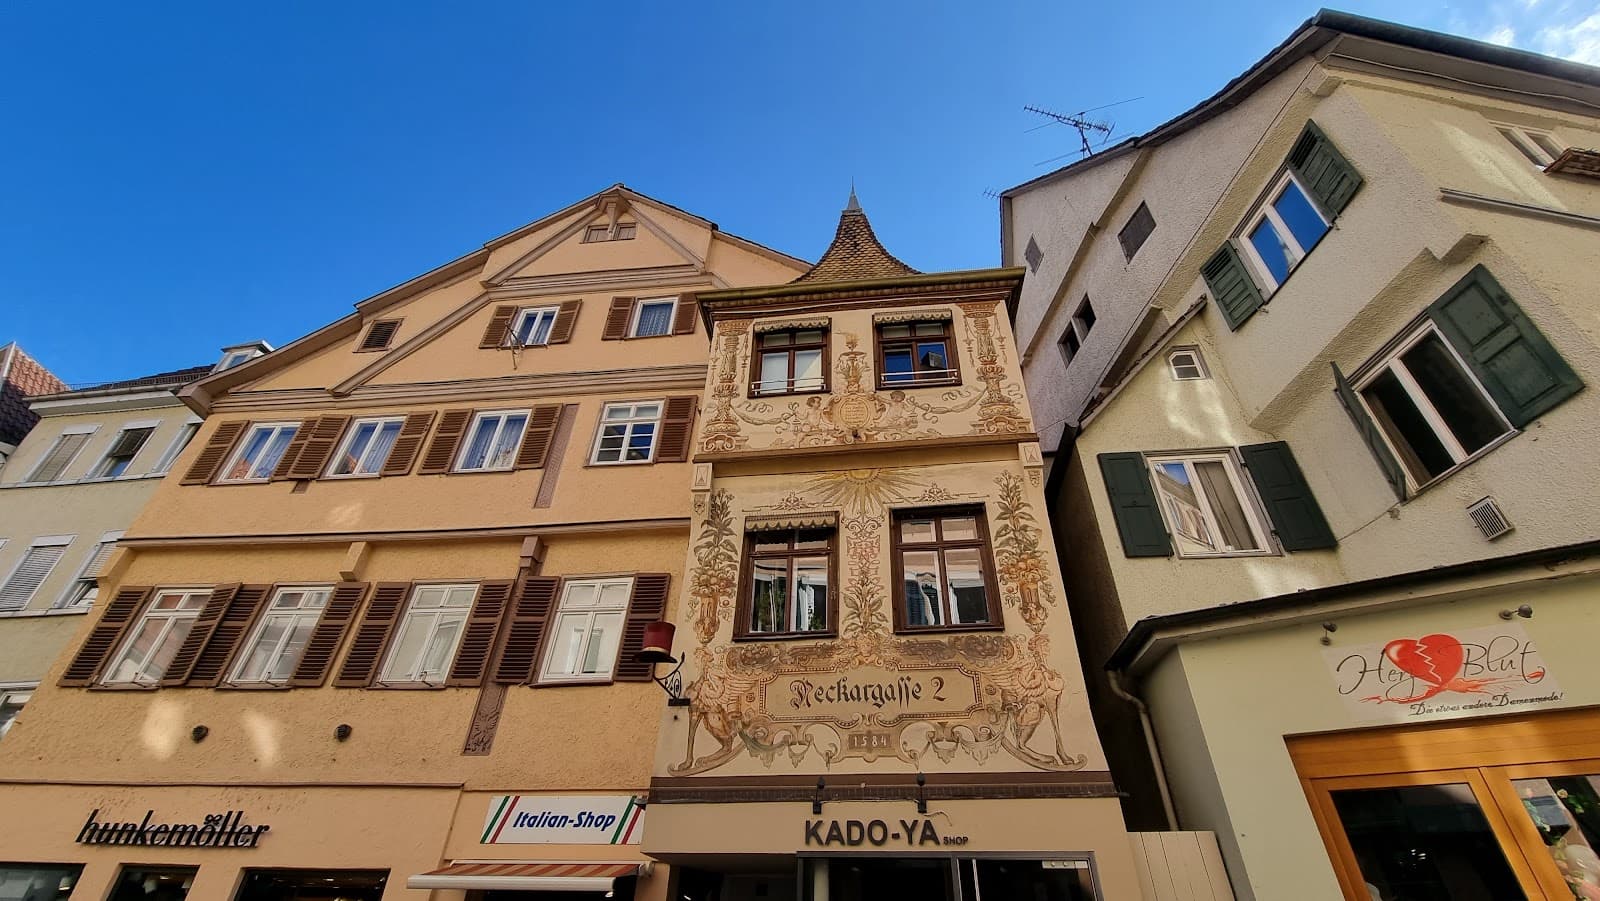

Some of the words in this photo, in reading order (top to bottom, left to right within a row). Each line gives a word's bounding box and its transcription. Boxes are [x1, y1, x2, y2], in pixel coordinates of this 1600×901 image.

[1455, 635, 1545, 684] Blut
[931, 676, 947, 701] 2
[1408, 703, 1433, 716] Die
[1462, 700, 1493, 710] andere
[854, 736, 887, 747] 1584
[75, 809, 270, 848] hunkemöller
[513, 811, 616, 831] Italian-Shop
[805, 820, 940, 846] KADO-YA
[943, 836, 969, 846] SHOP
